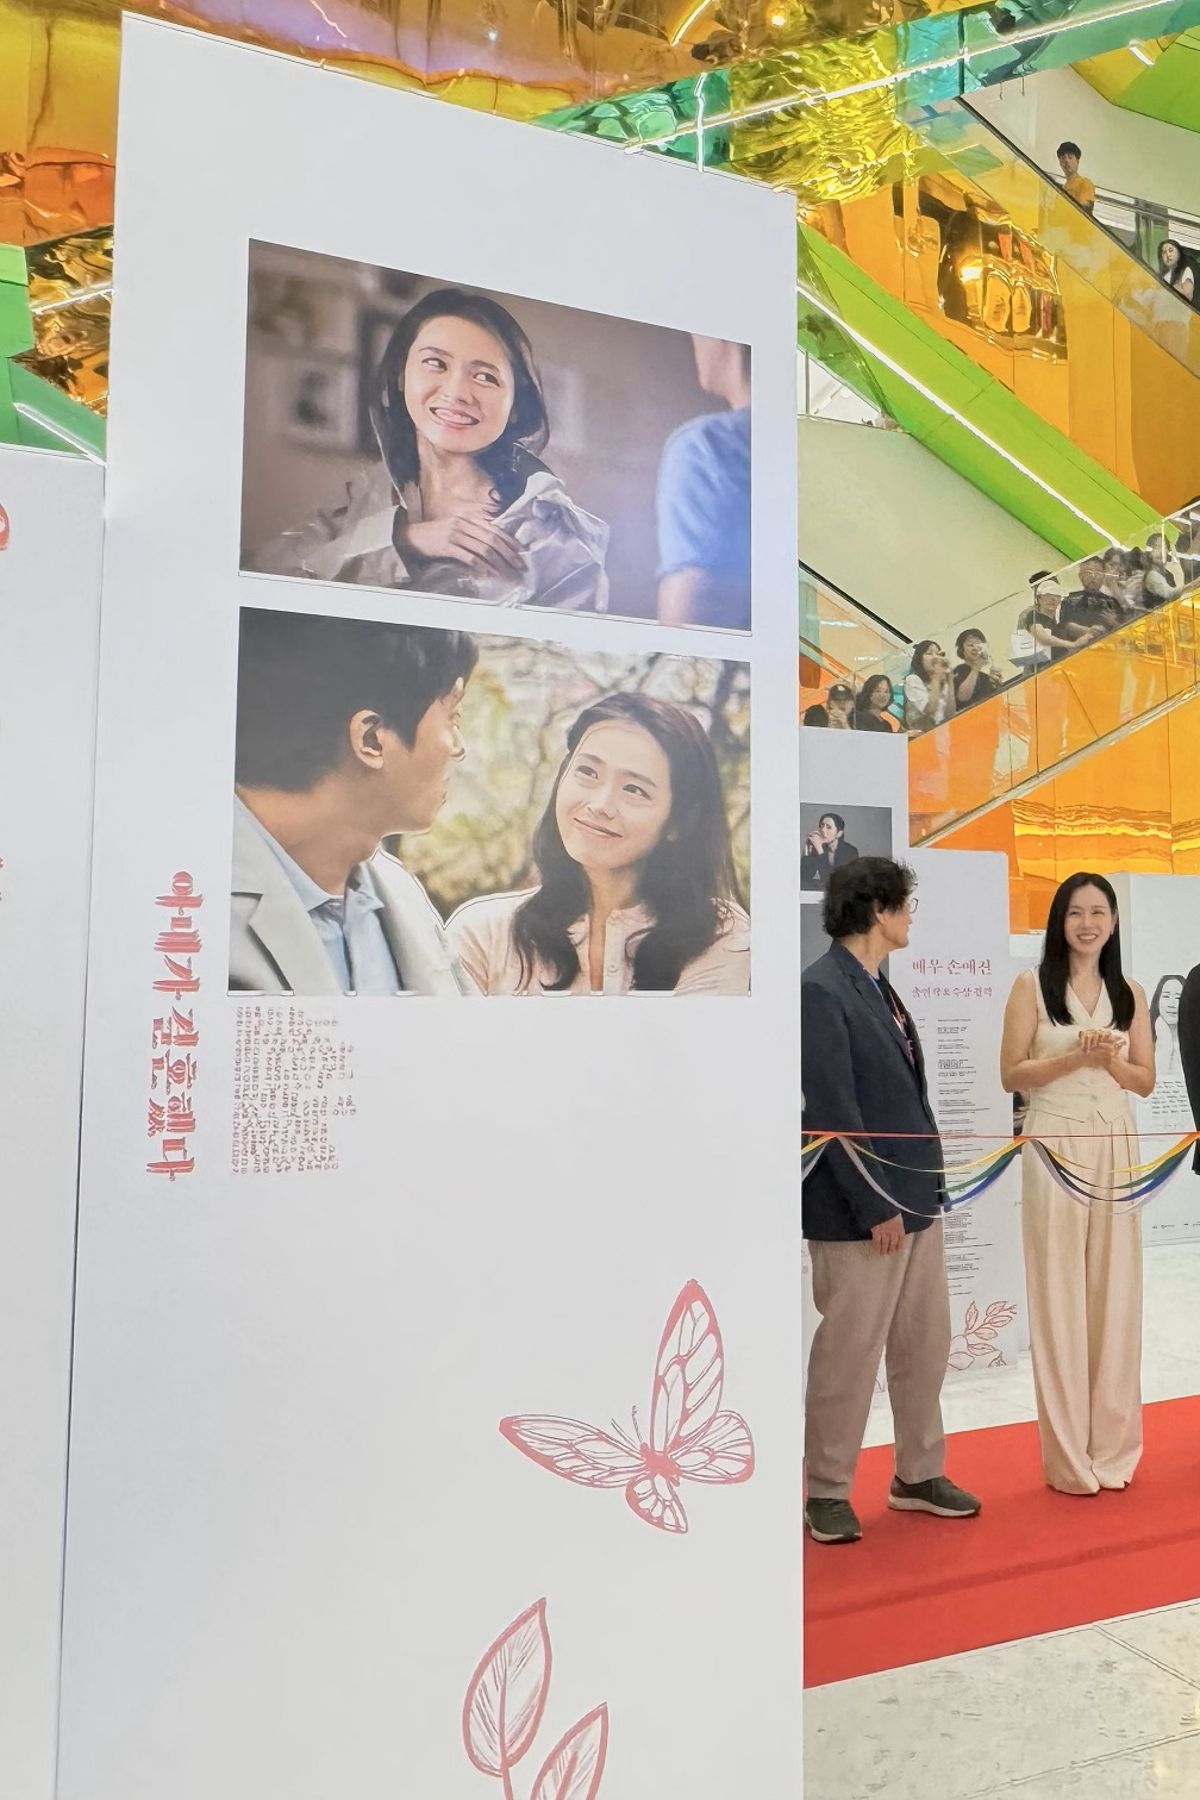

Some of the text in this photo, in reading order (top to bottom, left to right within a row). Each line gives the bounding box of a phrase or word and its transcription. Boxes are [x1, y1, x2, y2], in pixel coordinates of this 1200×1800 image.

[146, 870, 205, 1182] 아내가 결혼했다
[912, 958, 993, 976] 배우 손예진
